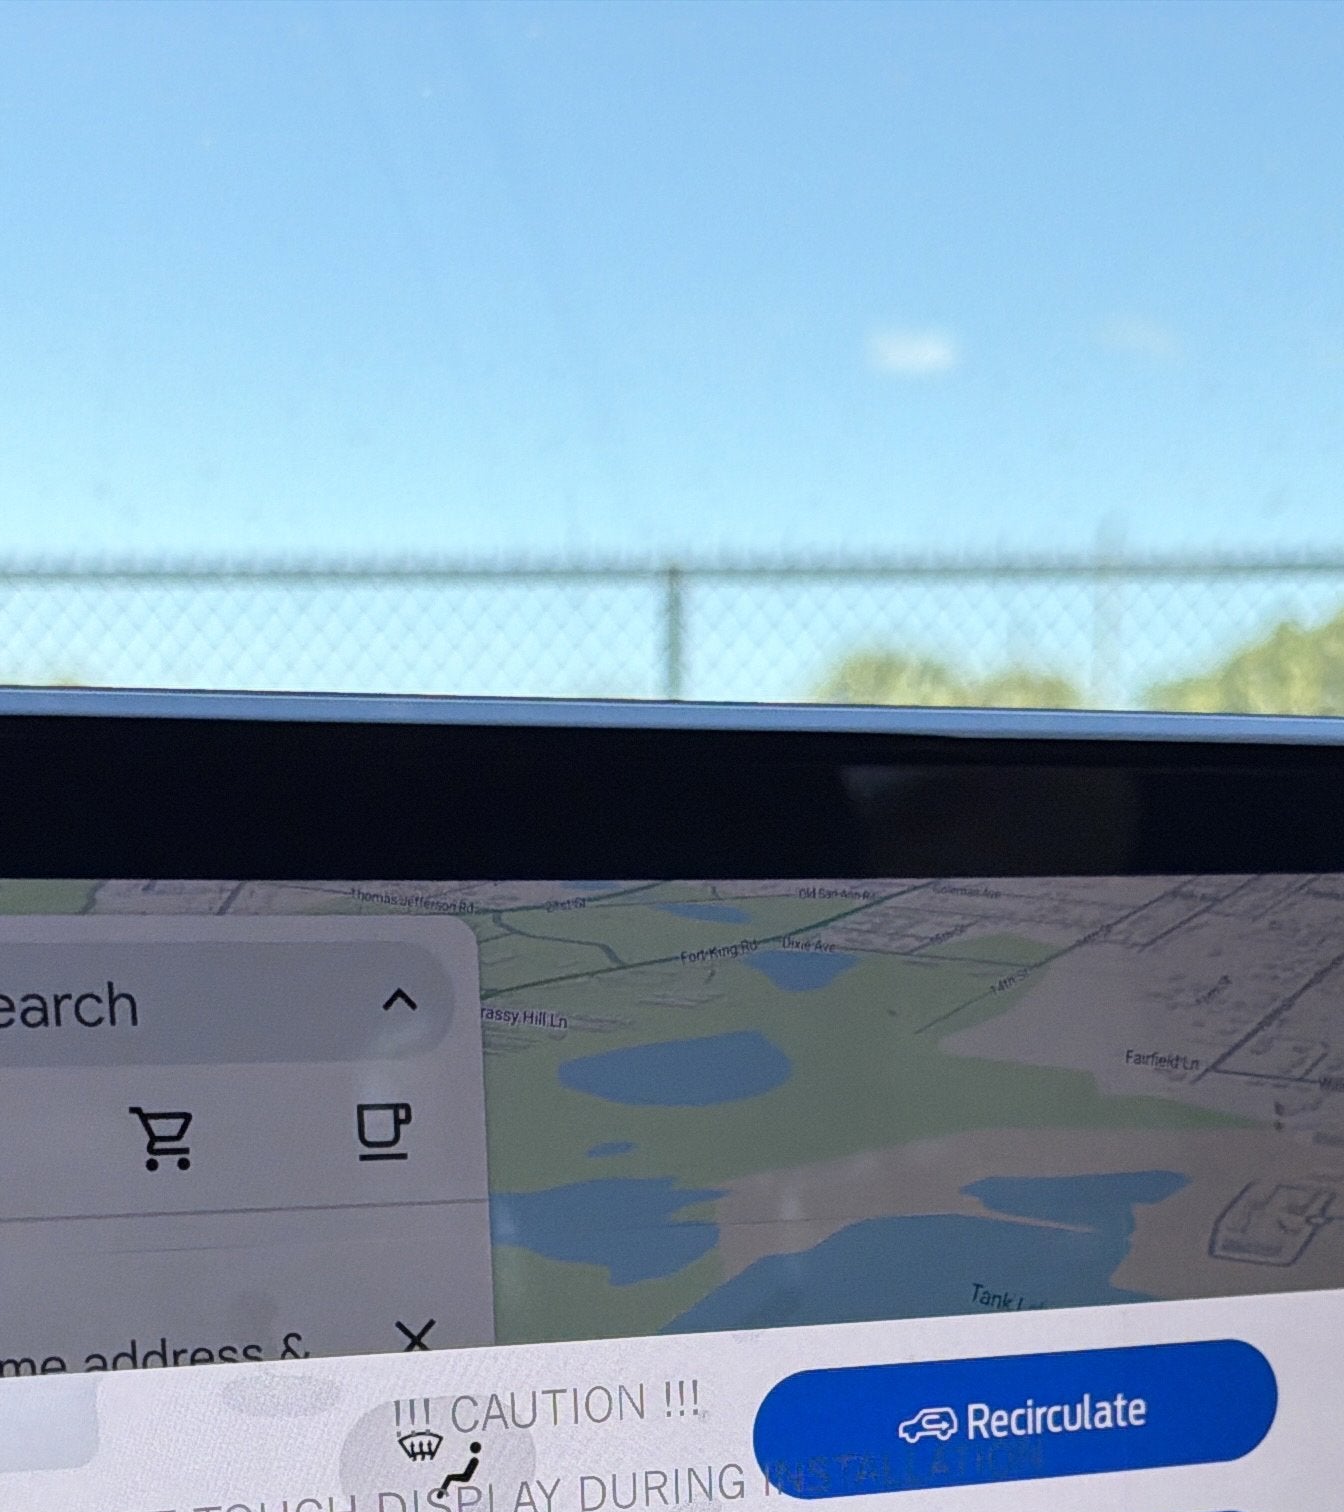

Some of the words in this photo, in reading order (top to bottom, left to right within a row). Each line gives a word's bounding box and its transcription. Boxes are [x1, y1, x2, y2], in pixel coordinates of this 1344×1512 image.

[459, 900, 474, 913] Rd
[681, 950, 705, 966] Fort
[709, 944, 739, 960] King
[480, 1006, 518, 1026] rassy
[523, 1010, 546, 1027] Hill
[550, 1014, 568, 1029] Ln
[1125, 1049, 1179, 1070] Fairfield
[971, 1282, 1013, 1310] Tank
[85, 1337, 263, 1372] address
[280, 1332, 311, 1360] &
[452, 1383, 646, 1434] CAUTION
[967, 1393, 1147, 1440] Recirculate
